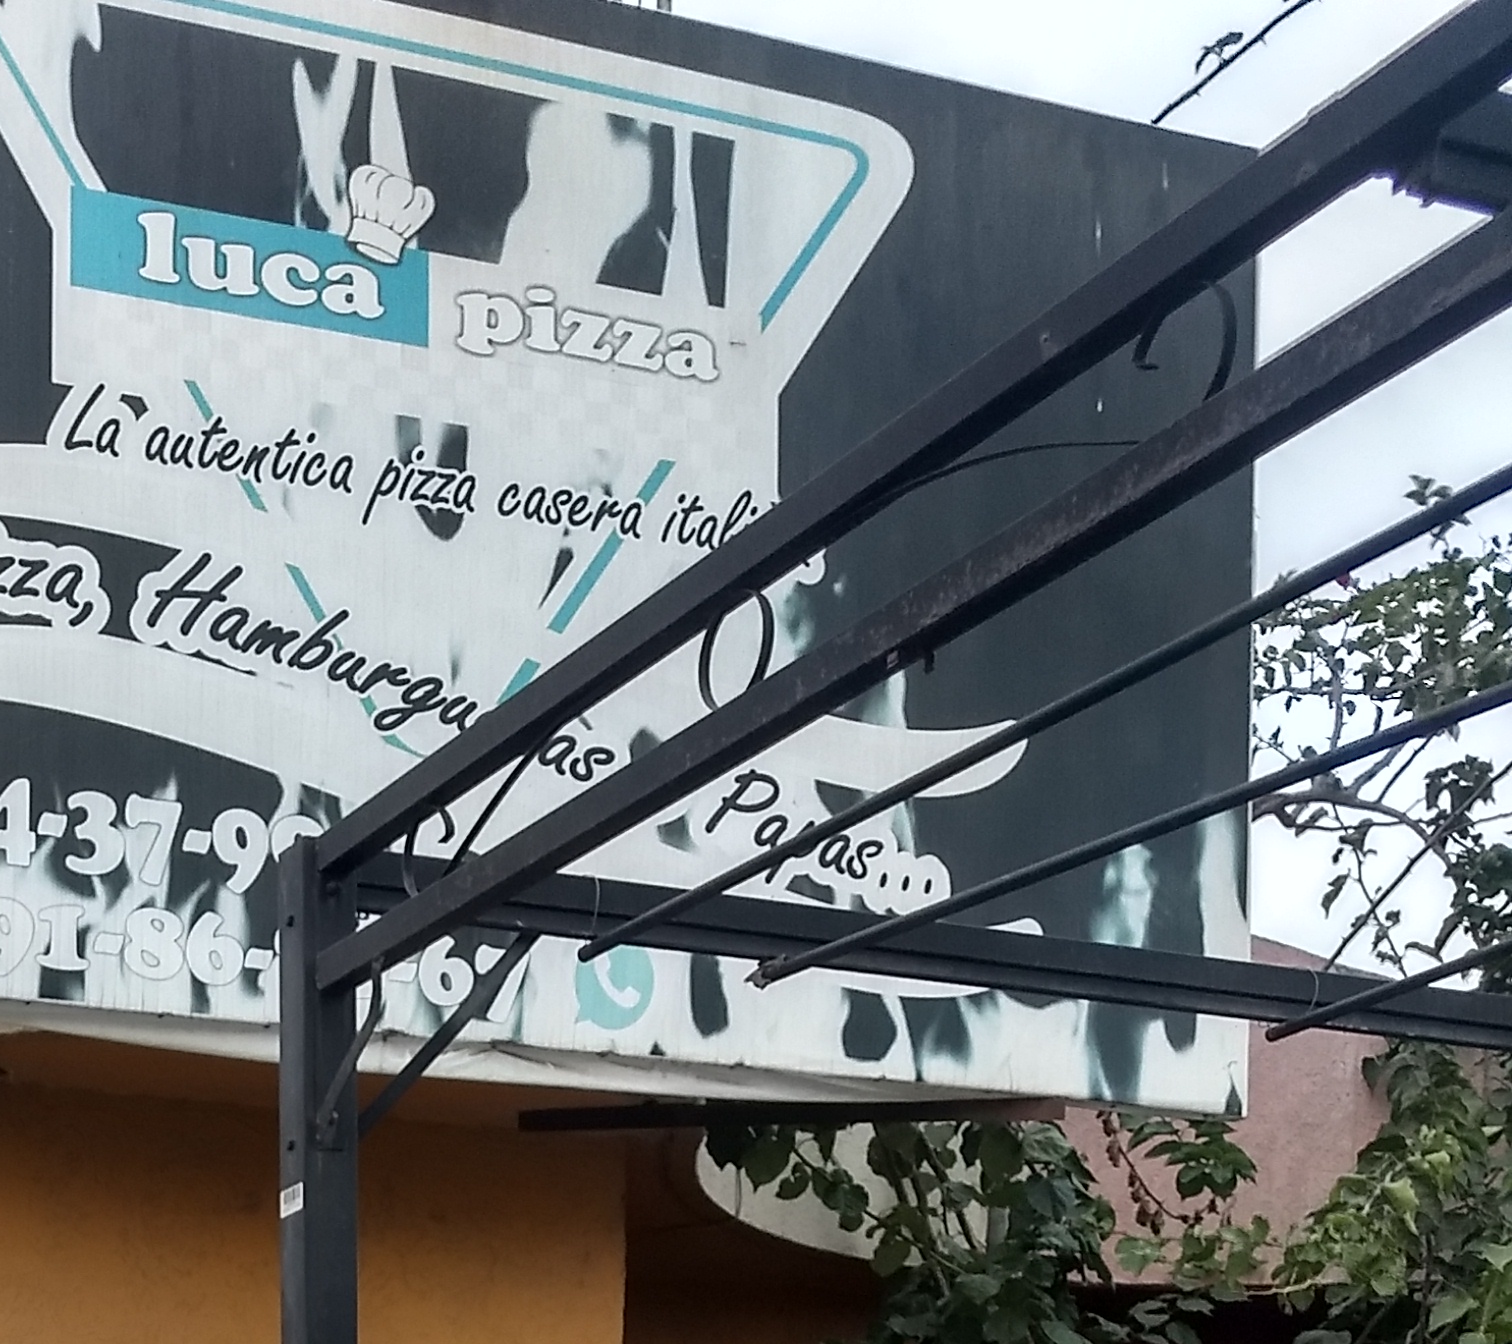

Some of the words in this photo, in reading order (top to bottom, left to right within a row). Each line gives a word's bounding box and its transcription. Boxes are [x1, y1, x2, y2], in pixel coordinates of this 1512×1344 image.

[138, 212, 386, 321] luca
[455, 285, 720, 384] pizza
[65, 383, 120, 457] La
[145, 416, 353, 494] autentica
[361, 450, 476, 526] pizza
[497, 480, 641, 538] casera
[148, 552, 615, 782] Hamburguas
